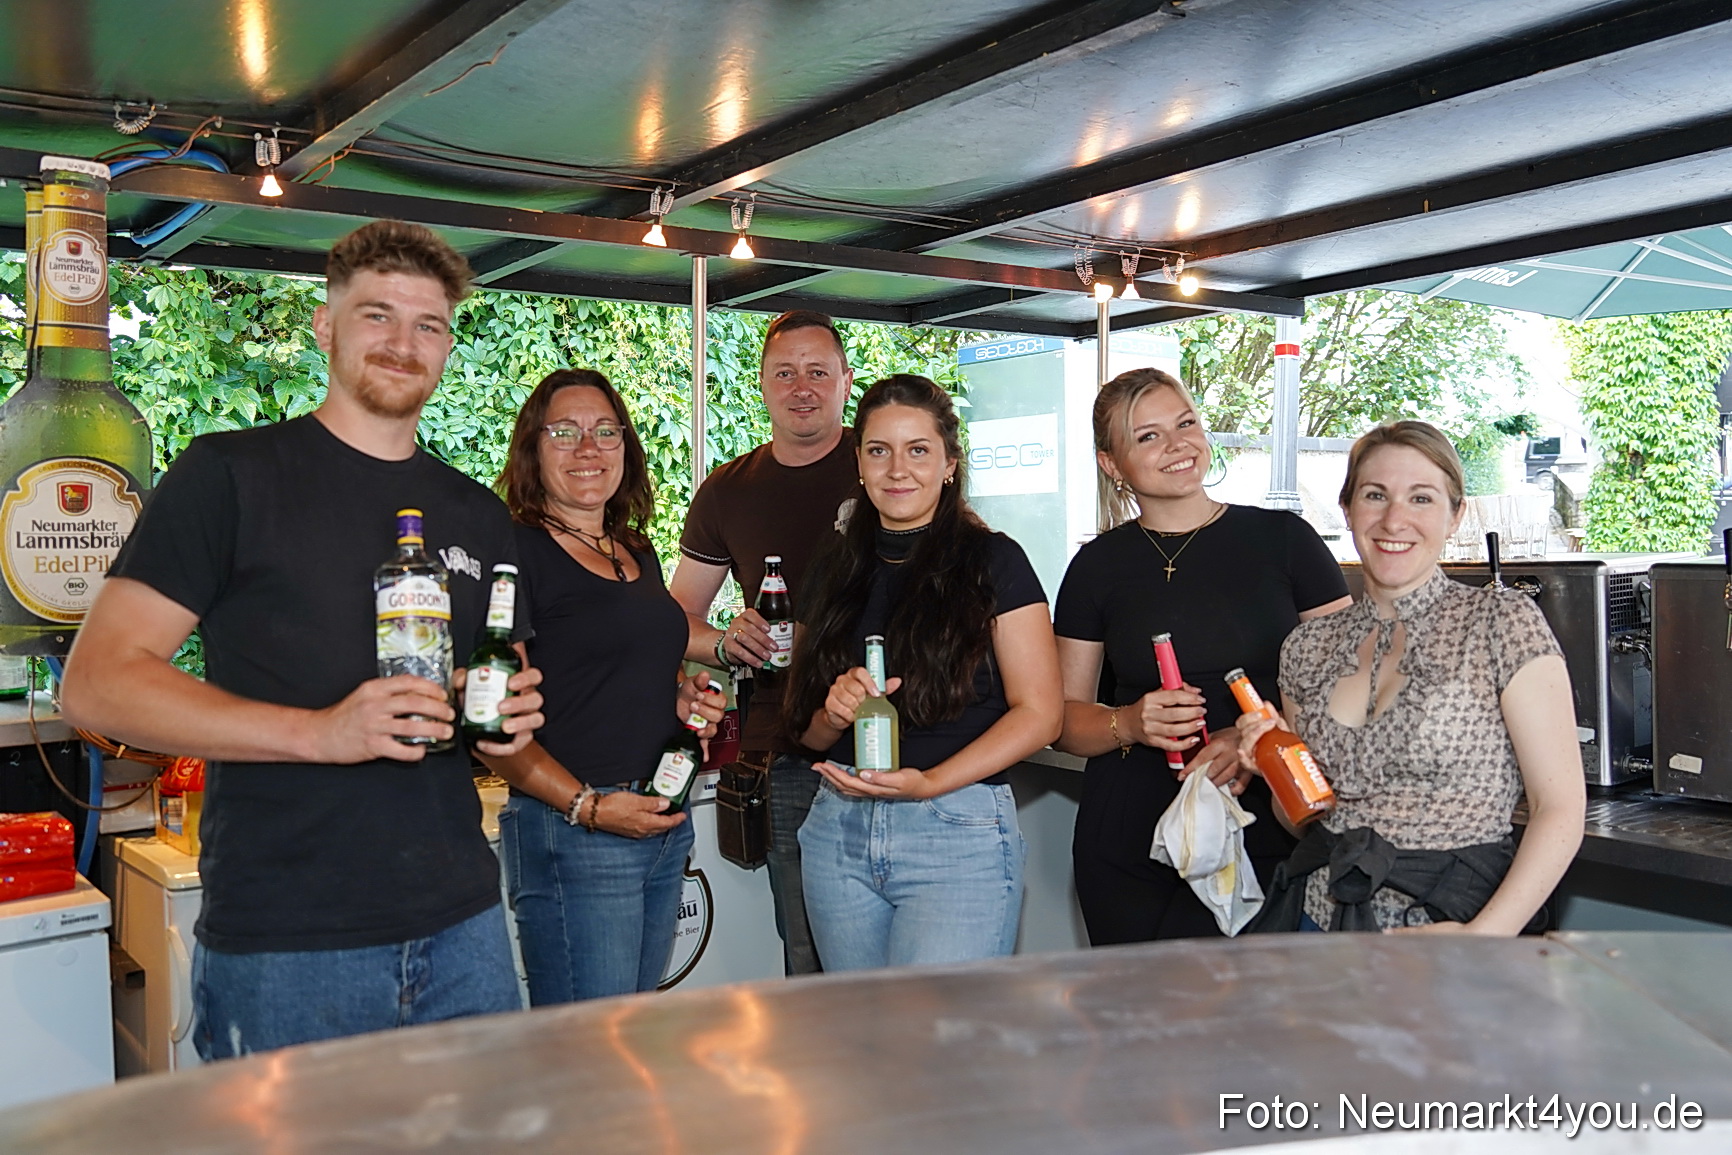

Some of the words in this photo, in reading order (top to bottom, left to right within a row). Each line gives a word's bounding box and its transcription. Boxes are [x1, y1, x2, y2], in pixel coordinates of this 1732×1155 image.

[56, 257, 94, 265] Neumarkter
[49, 262, 100, 274] Lammsbräu
[55, 272, 76, 282] Edel
[78, 274, 96, 285] Pils
[1030, 449, 1055, 459] TOWER
[31, 519, 118, 532] Neumarkter
[34, 555, 79, 573] Edel
